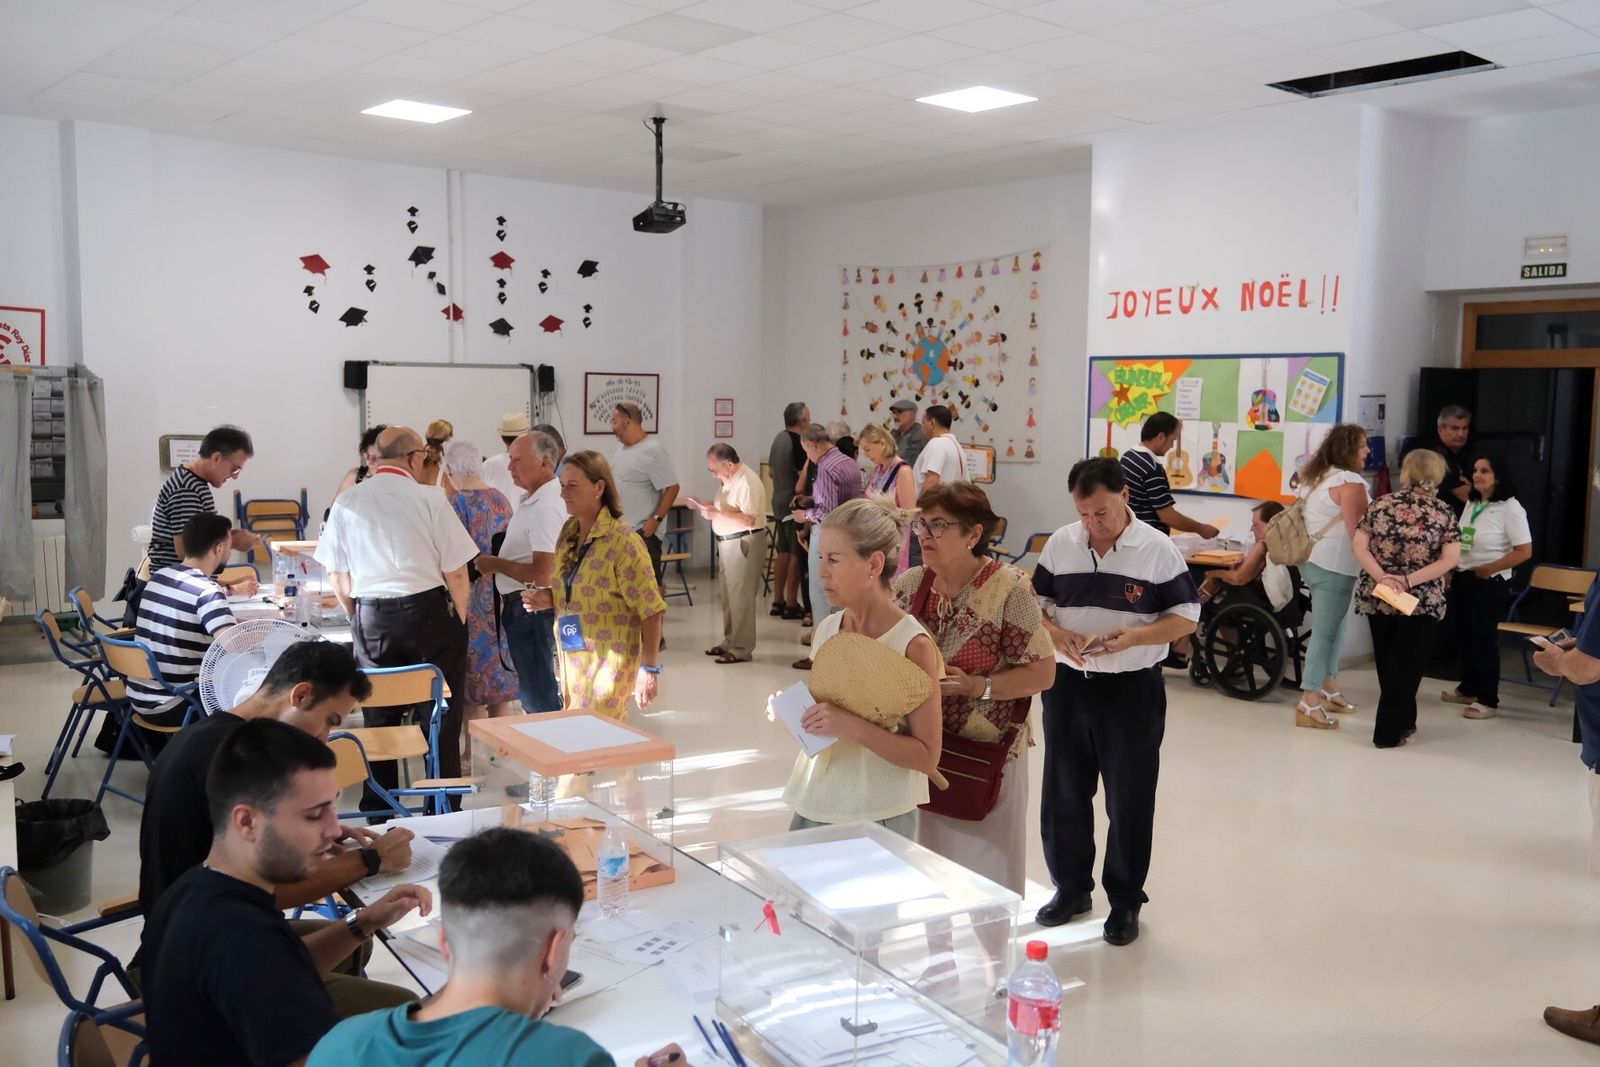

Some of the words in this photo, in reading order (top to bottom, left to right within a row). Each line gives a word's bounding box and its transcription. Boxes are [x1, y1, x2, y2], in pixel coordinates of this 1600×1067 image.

[1523, 265, 1563, 278] SALIDA
[1107, 287, 1219, 319] JOYEUX
[1240, 274, 1339, 314] NOËL!!
